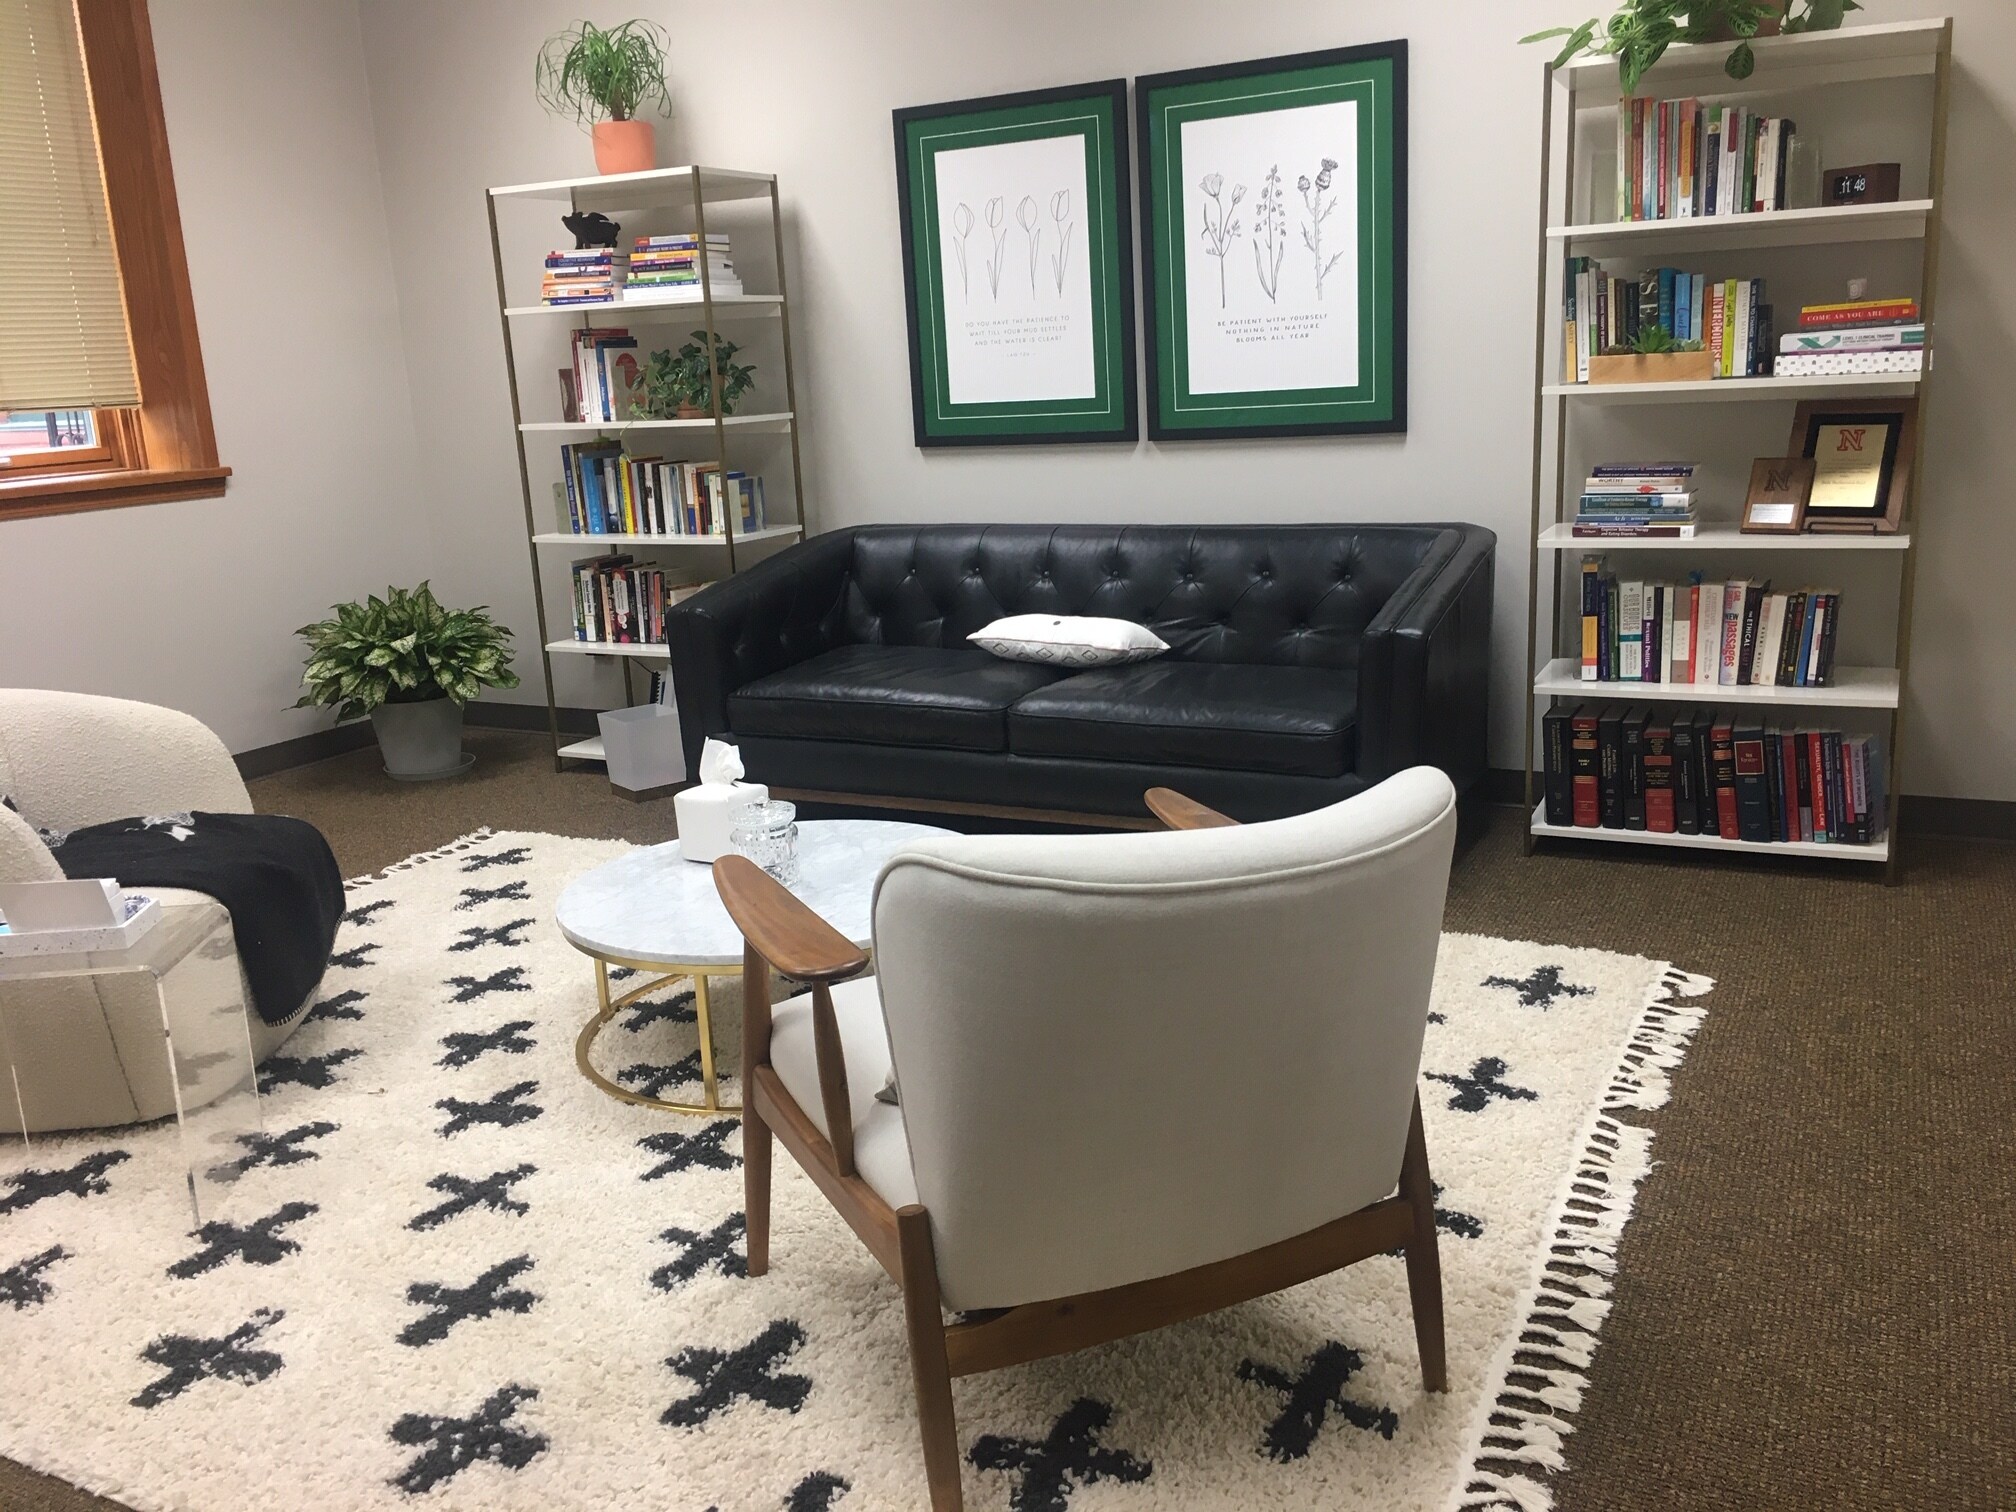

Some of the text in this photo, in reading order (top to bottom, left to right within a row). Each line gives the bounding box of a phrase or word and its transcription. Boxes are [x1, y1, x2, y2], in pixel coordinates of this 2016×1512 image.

[1841, 177, 1866, 193] 11 48
[1750, 308, 1756, 316] TO
[1807, 314, 1831, 322] COME
[1847, 311, 1865, 319] YOU
[1867, 309, 1885, 317] ARE
[1026, 316, 1058, 324] PATIENCE
[1061, 314, 1070, 322] TO
[1230, 318, 1262, 326] PATIENT
[1289, 313, 1328, 322] YOURSELF
[1040, 325, 1067, 333] SETTLES
[1225, 327, 1265, 335] NOTHING
[1284, 323, 1320, 331] NATURE
[1837, 429, 1866, 451] N
[1764, 469, 1792, 492] N
[1744, 618, 1754, 646] ETHICAL
[1722, 621, 1738, 667] passages
